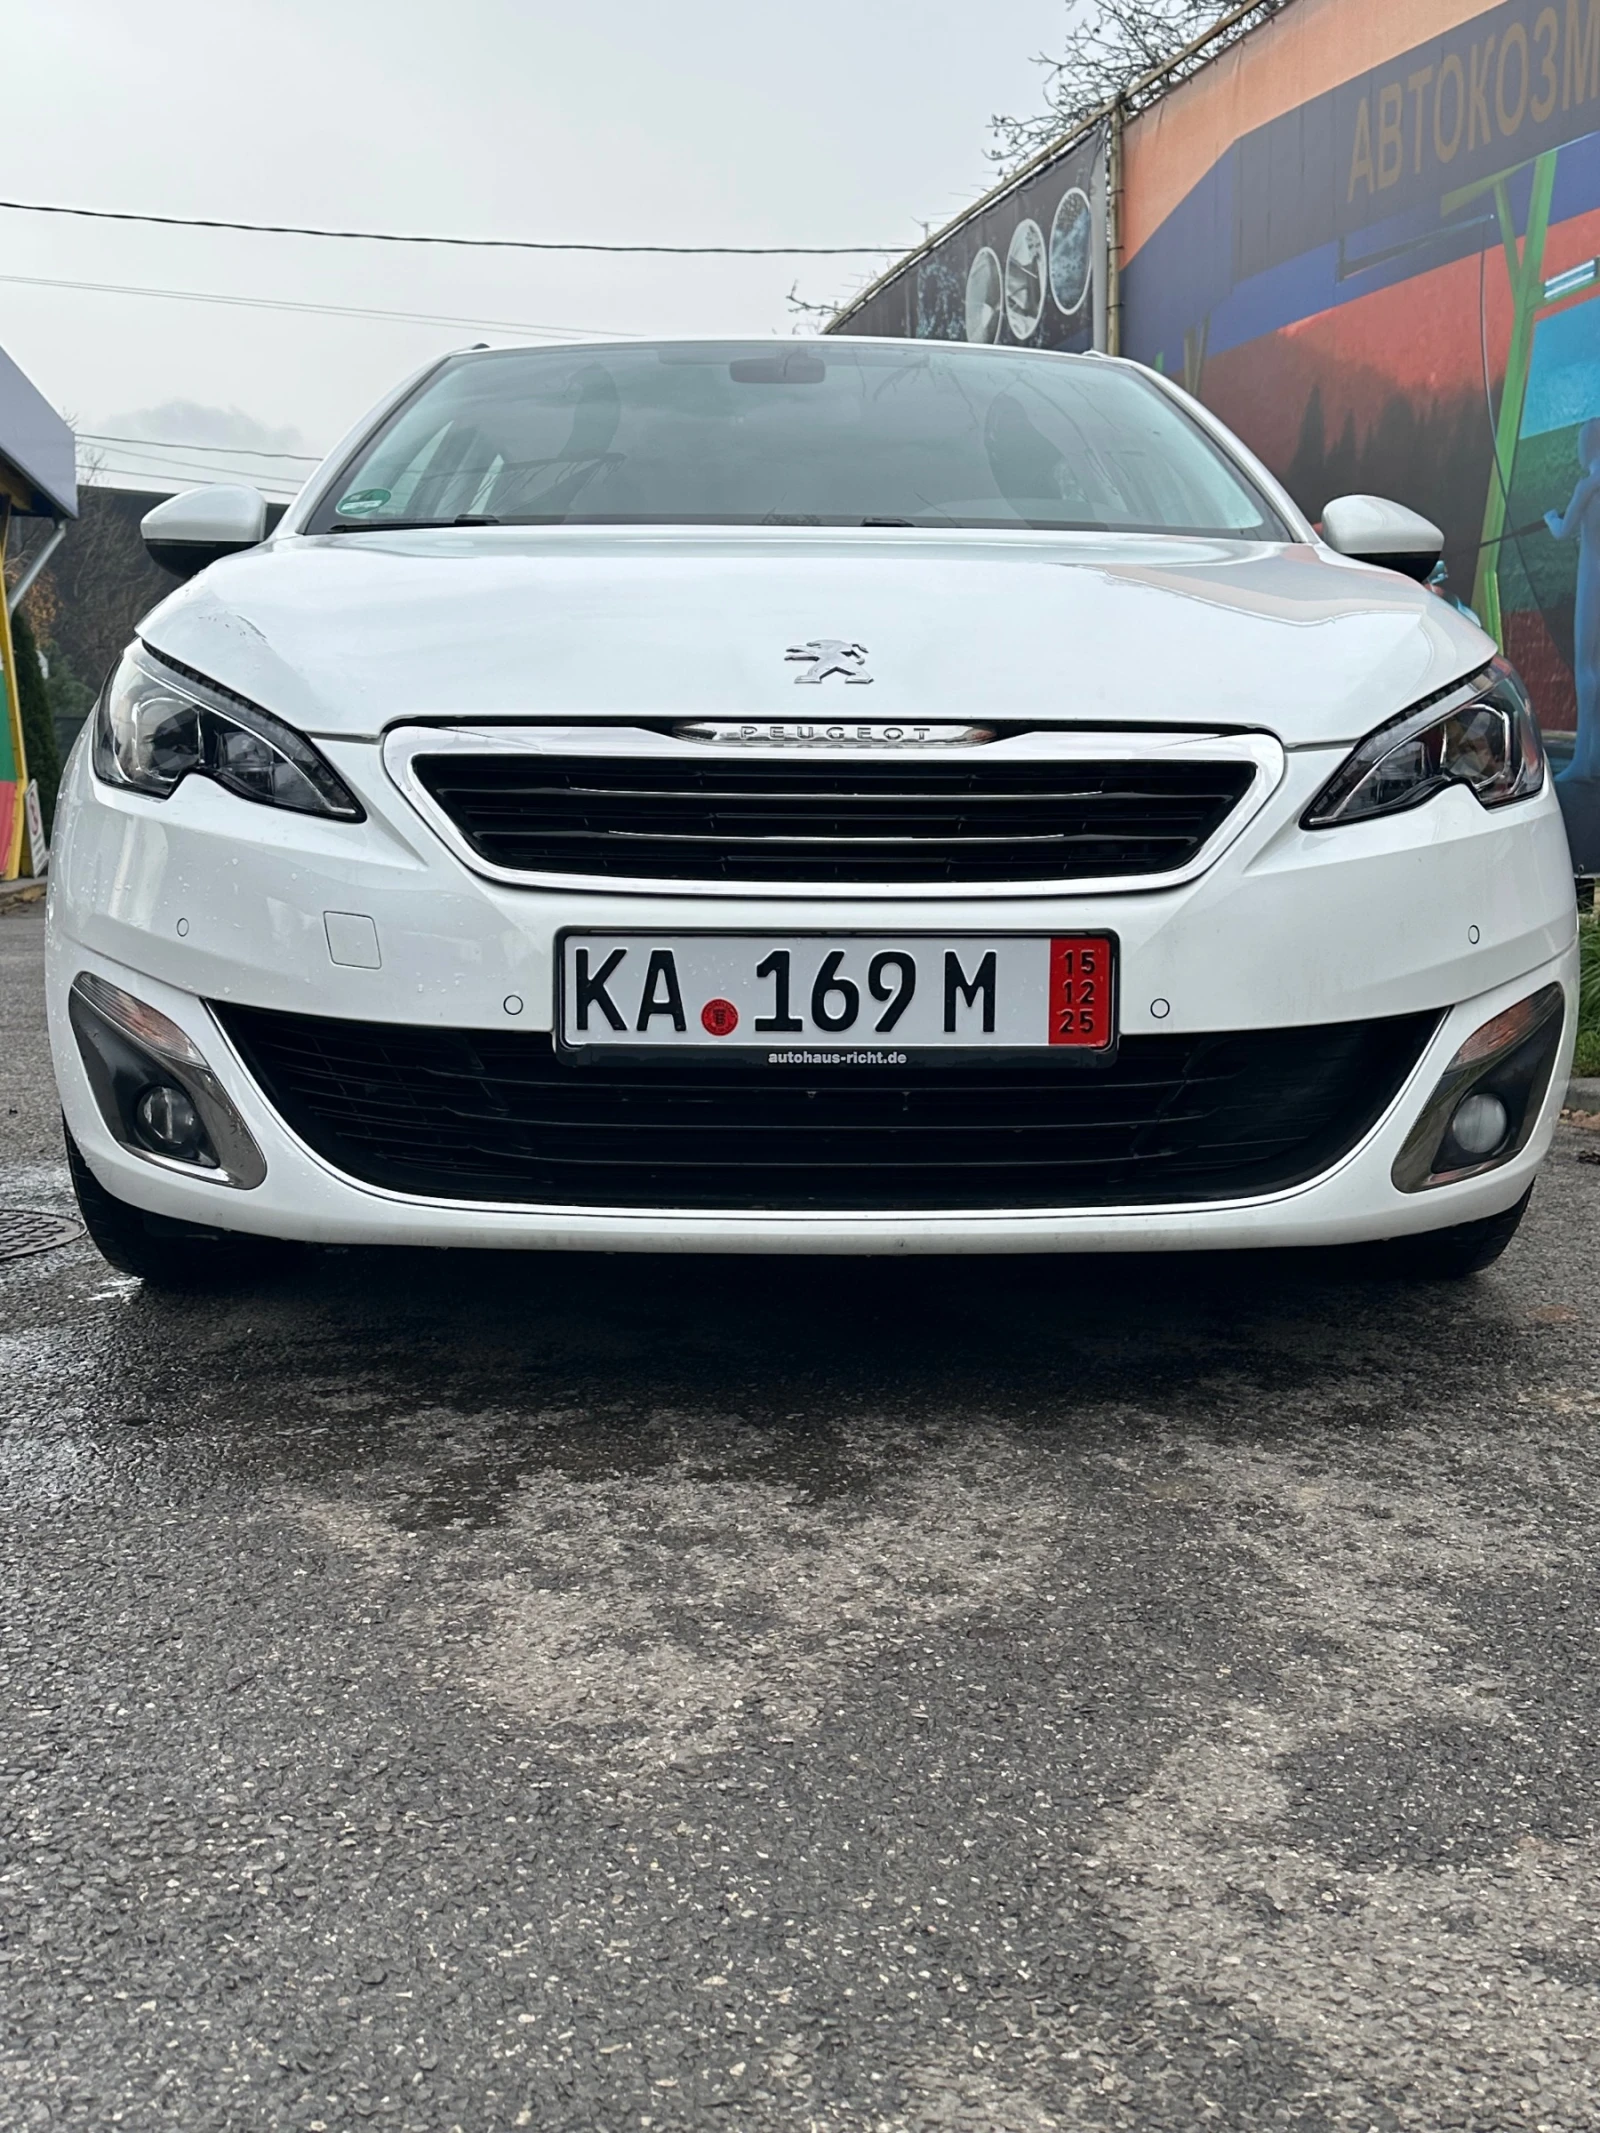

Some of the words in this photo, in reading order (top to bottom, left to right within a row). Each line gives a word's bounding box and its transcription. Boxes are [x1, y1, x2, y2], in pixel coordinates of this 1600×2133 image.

[740, 725, 931, 741] PEUGEOT
[1060, 949, 1096, 975] 15
[575, 948, 687, 1032] KA
[754, 949, 917, 1033] 169
[943, 951, 997, 1033] M
[1062, 979, 1096, 1005] 12
[1059, 1008, 1095, 1034] 25
[768, 1050, 908, 1064] autohaus-richt.de
